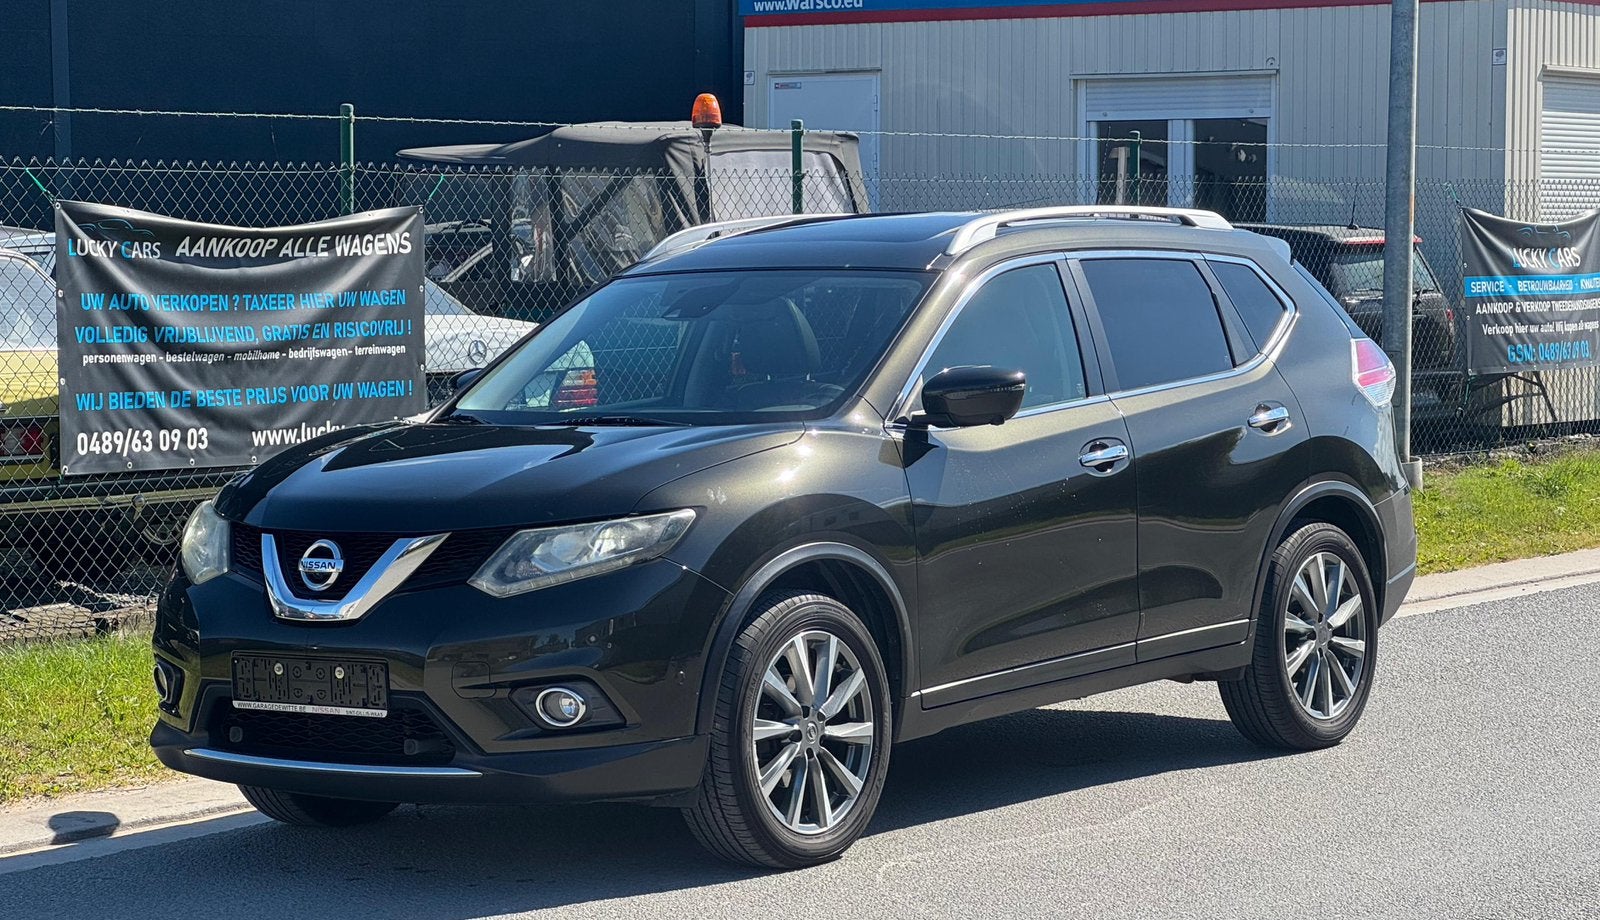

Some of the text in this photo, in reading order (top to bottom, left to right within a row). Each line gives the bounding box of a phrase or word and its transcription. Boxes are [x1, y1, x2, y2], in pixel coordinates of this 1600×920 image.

[68, 238, 161, 259] LUCKY CARS
[175, 232, 412, 258] AANKOOP ALLE WAGENS
[1512, 247, 1580, 268] LUCKY CARS
[1470, 281, 1505, 293] SERVICE
[81, 289, 406, 312] UW AUTO VERKOPEN ? TAXEER HIER UW WAGEN
[1476, 301, 1514, 315] AANKOOP
[1515, 301, 1521, 312] &
[1521, 301, 1551, 313] VERKOOP
[74, 319, 412, 345] VOLLEDIG VRIJBLIJVEND, GRATIS EN RISICOVRIJ !
[1482, 323, 1514, 336] Verkoop
[1515, 322, 1529, 334] hier
[1529, 324, 1540, 333] uw
[1540, 321, 1555, 333] auto!
[1555, 321, 1564, 335] Wij
[82, 352, 157, 367] personenwagen
[165, 351, 225, 365] bestelwagen
[233, 350, 281, 361] mobilhome
[354, 344, 407, 357] terreinwagen
[1507, 343, 1537, 363] GSM:
[1538, 341, 1571, 363] 0489/63
[75, 379, 413, 411] WIJ BIEDEN DE BESTE PRIJS VOOR UW WAGEN !
[76, 427, 209, 457] 0489/63 09 03
[301, 561, 336, 570] NISSAN
[237, 702, 307, 713] WWW.GARAGEDEWITTE.BE
[311, 707, 341, 715] NISSAN
